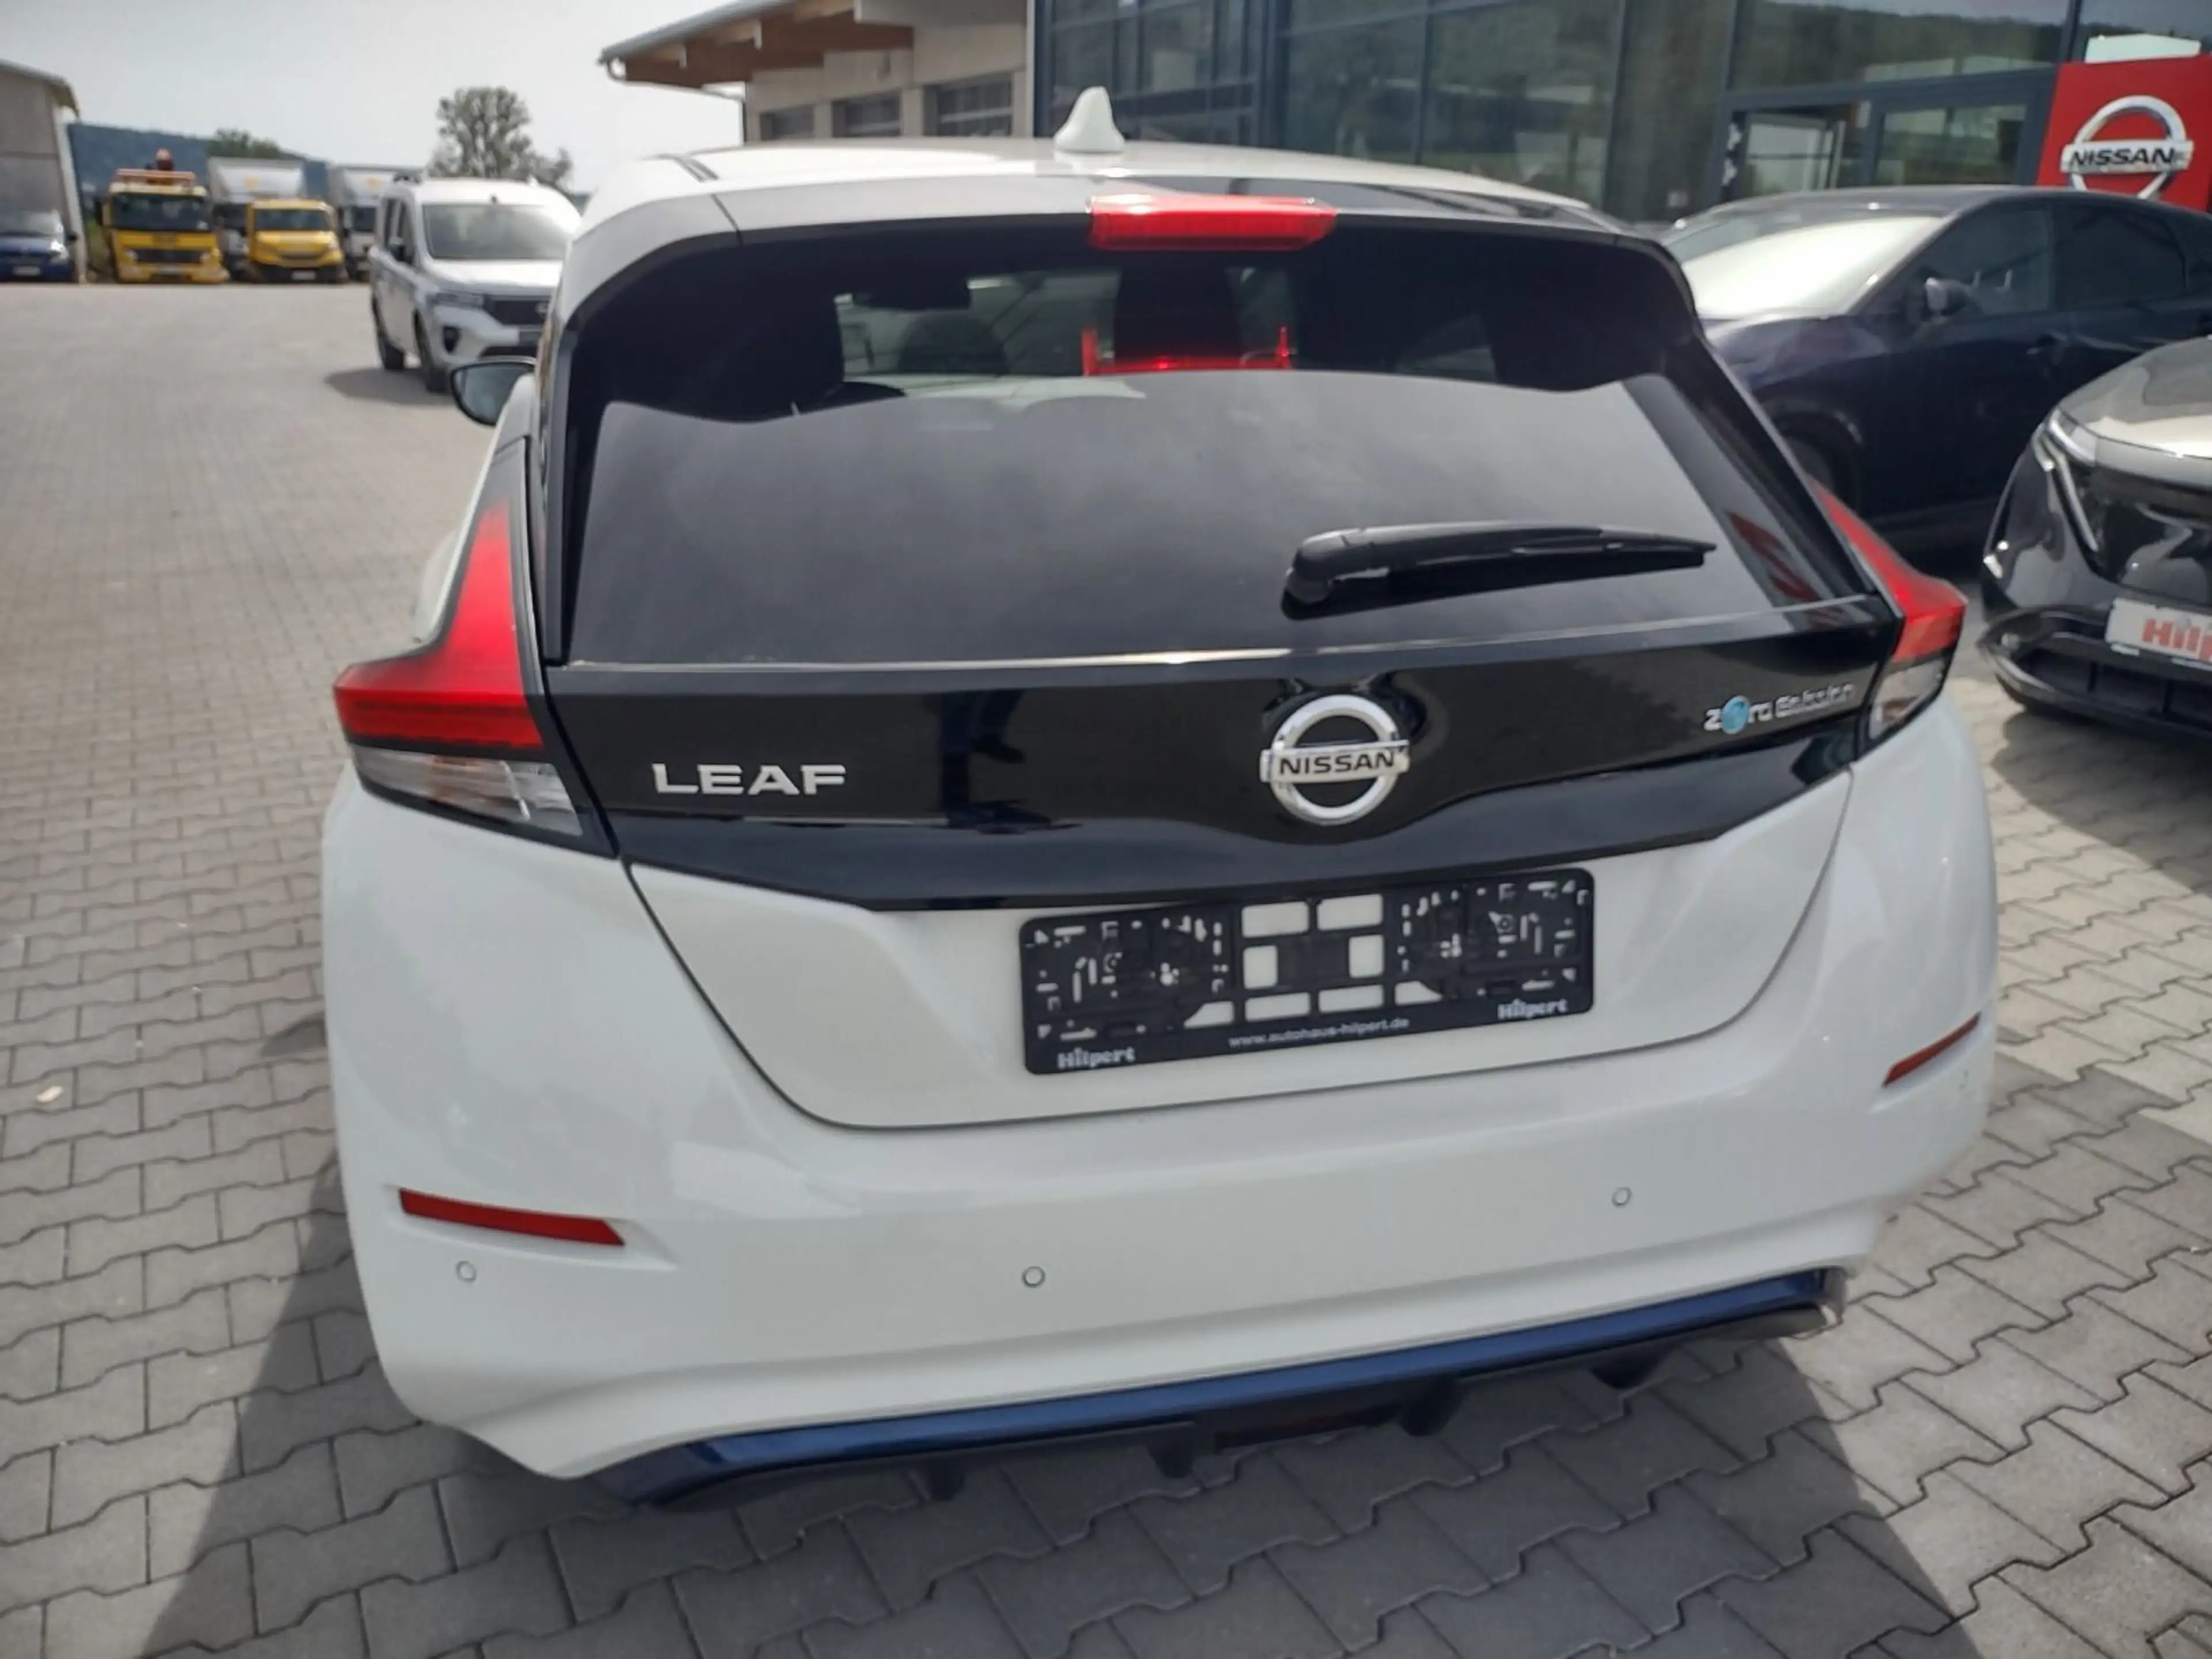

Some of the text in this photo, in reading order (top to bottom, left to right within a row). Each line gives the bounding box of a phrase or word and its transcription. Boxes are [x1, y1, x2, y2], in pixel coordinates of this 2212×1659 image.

[2070, 147, 2175, 166] NISSAN
[1280, 751, 1395, 775] NISSAN
[652, 763, 847, 795] LEAF
